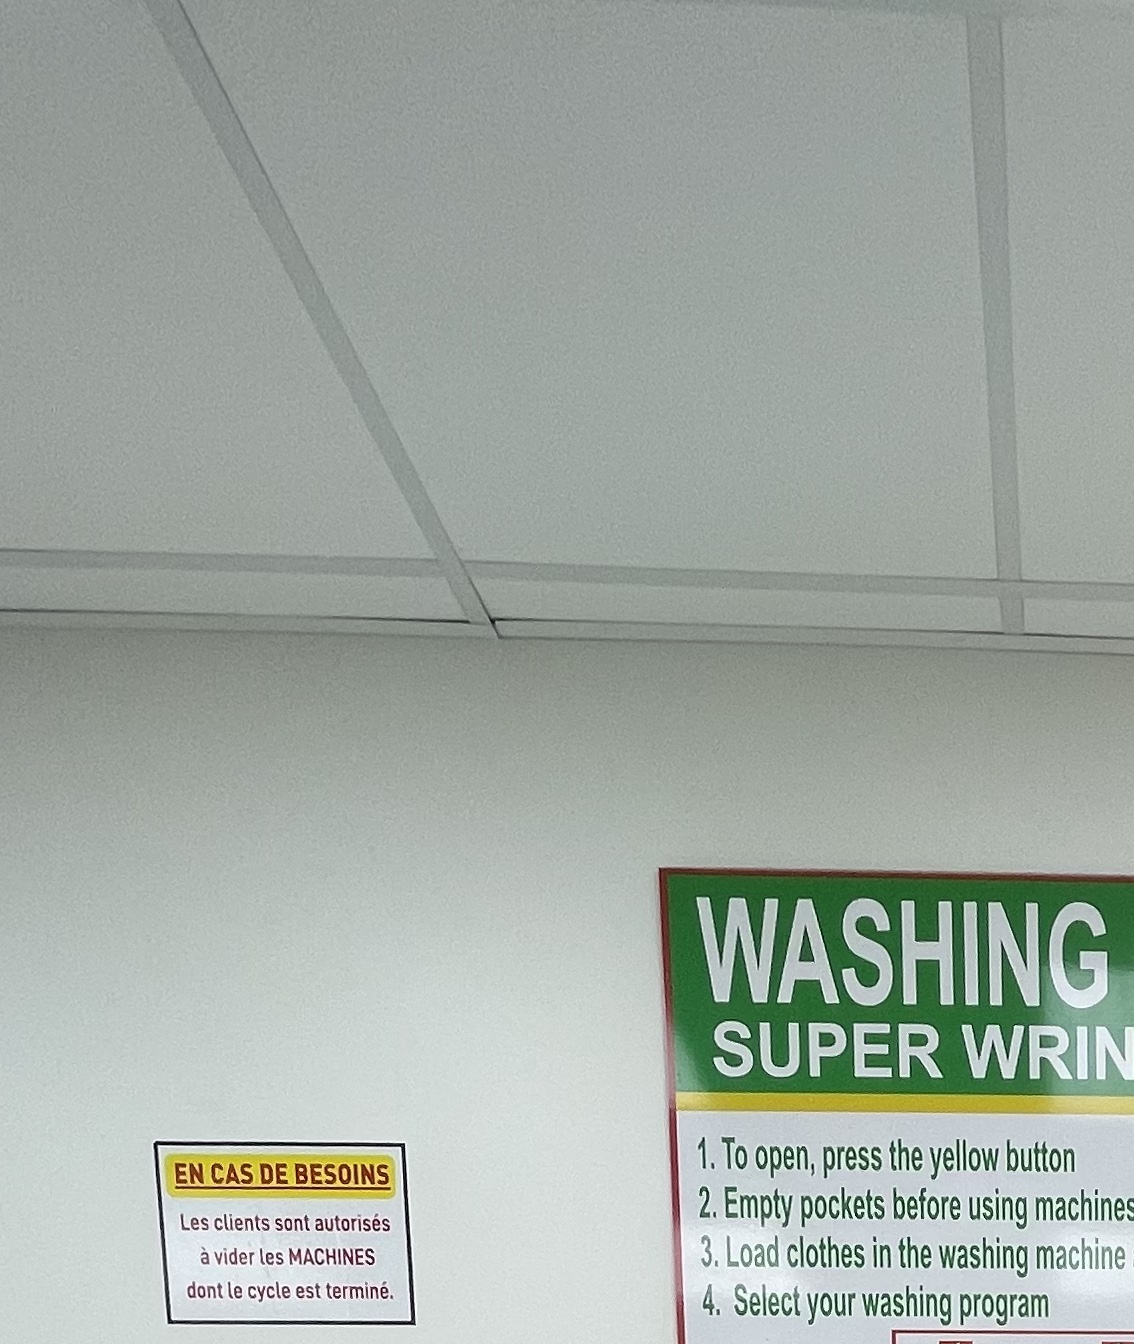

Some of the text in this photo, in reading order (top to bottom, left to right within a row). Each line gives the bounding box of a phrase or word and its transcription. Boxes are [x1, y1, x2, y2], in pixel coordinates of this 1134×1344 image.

[696, 896, 1109, 1010] WASHING
[713, 1021, 943, 1079] SUPER
[174, 1162, 389, 1185] EN CAS DE BESOINS
[698, 1137, 1074, 1181] 1. To open, press the yellow button
[180, 1213, 391, 1232] Les clients sont autorisés
[699, 1186, 716, 1219] 2.
[725, 1187, 793, 1228] Empty
[801, 1186, 885, 1227] pockets
[893, 1187, 960, 1220] before
[969, 1188, 1027, 1230] using
[200, 1246, 376, 1267] à vider les MACHINES
[701, 1235, 718, 1268] 3.
[727, 1234, 778, 1268] Load
[787, 1235, 864, 1269] clothes
[873, 1236, 891, 1269] in
[899, 1236, 931, 1268] the
[939, 1237, 1028, 1278] washing
[1037, 1238, 1125, 1270] machine
[187, 1281, 394, 1303] dont le cycle est terminé.
[703, 1284, 1048, 1326] 4. Select your washing program
